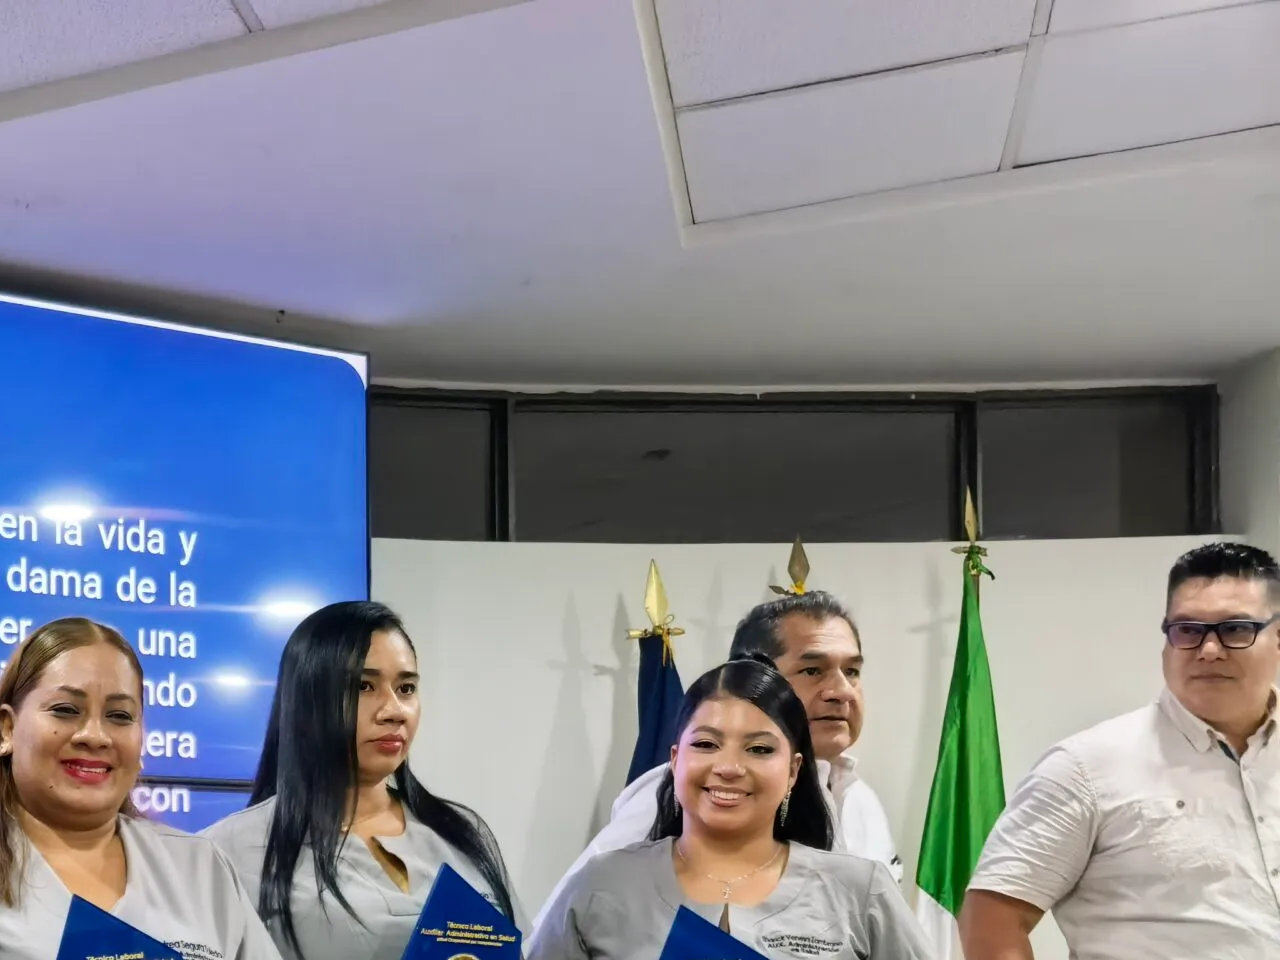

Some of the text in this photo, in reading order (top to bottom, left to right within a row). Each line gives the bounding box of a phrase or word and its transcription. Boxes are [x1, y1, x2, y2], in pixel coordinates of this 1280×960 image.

[55, 516, 83, 547] la
[99, 517, 165, 555] vida
[179, 531, 197, 565] y
[6, 559, 103, 601] dama
[116, 566, 158, 604] de
[169, 571, 197, 609] la
[138, 627, 197, 659] una
[115, 952, 144, 960] Laboral
